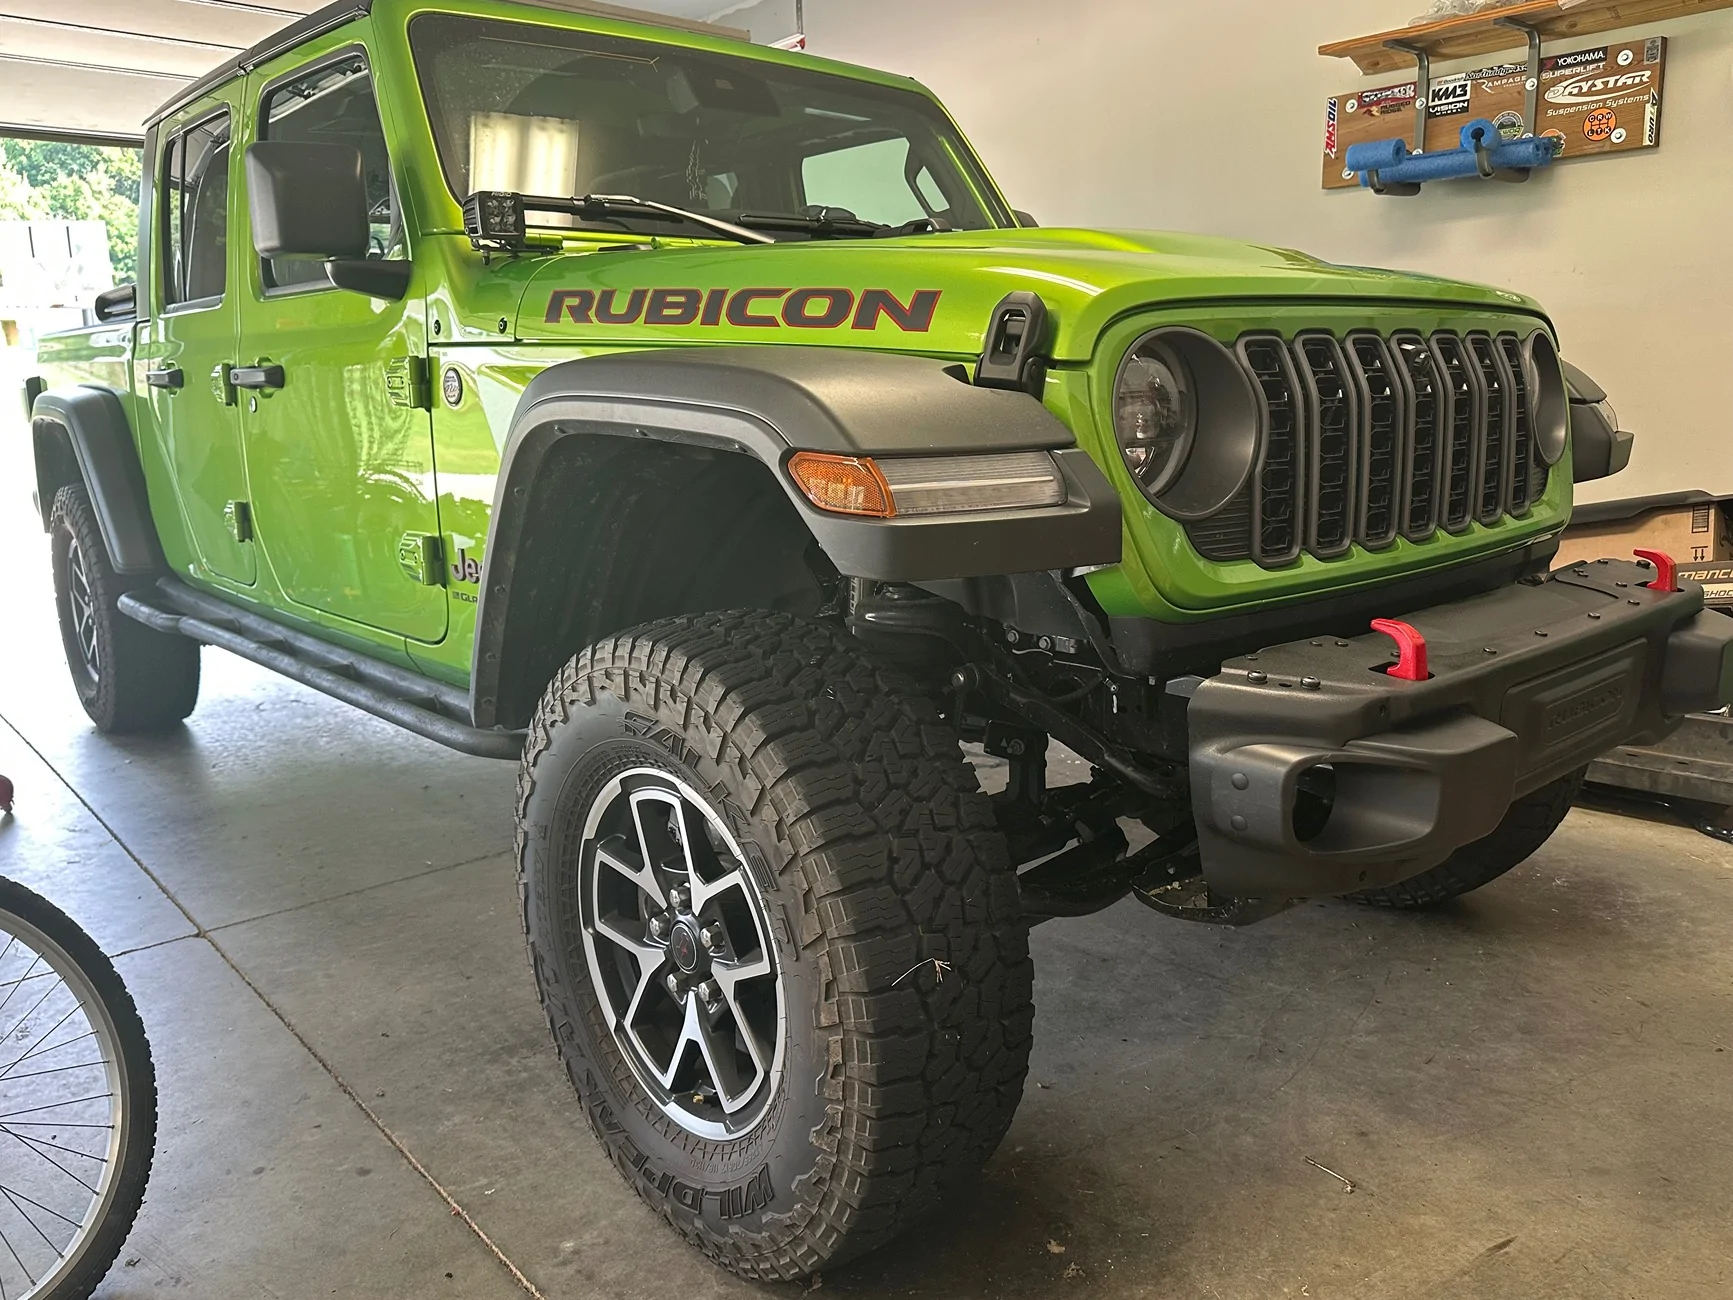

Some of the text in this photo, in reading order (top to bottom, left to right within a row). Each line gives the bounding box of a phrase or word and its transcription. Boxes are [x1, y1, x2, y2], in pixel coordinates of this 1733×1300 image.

[1556, 51, 1605, 67] YOKOHAMA
[1541, 63, 1606, 80] SUPERLIFT
[1431, 84, 1468, 103] KM3
[1473, 75, 1527, 94] RAMPAGE
[1547, 70, 1652, 99] DAYSTAR
[1429, 101, 1468, 113] VISION
[1546, 94, 1649, 117] Suspension Systems
[1324, 97, 1338, 158] AMSOIL
[544, 287, 943, 333] RUBICON
[451, 548, 483, 585] Je
